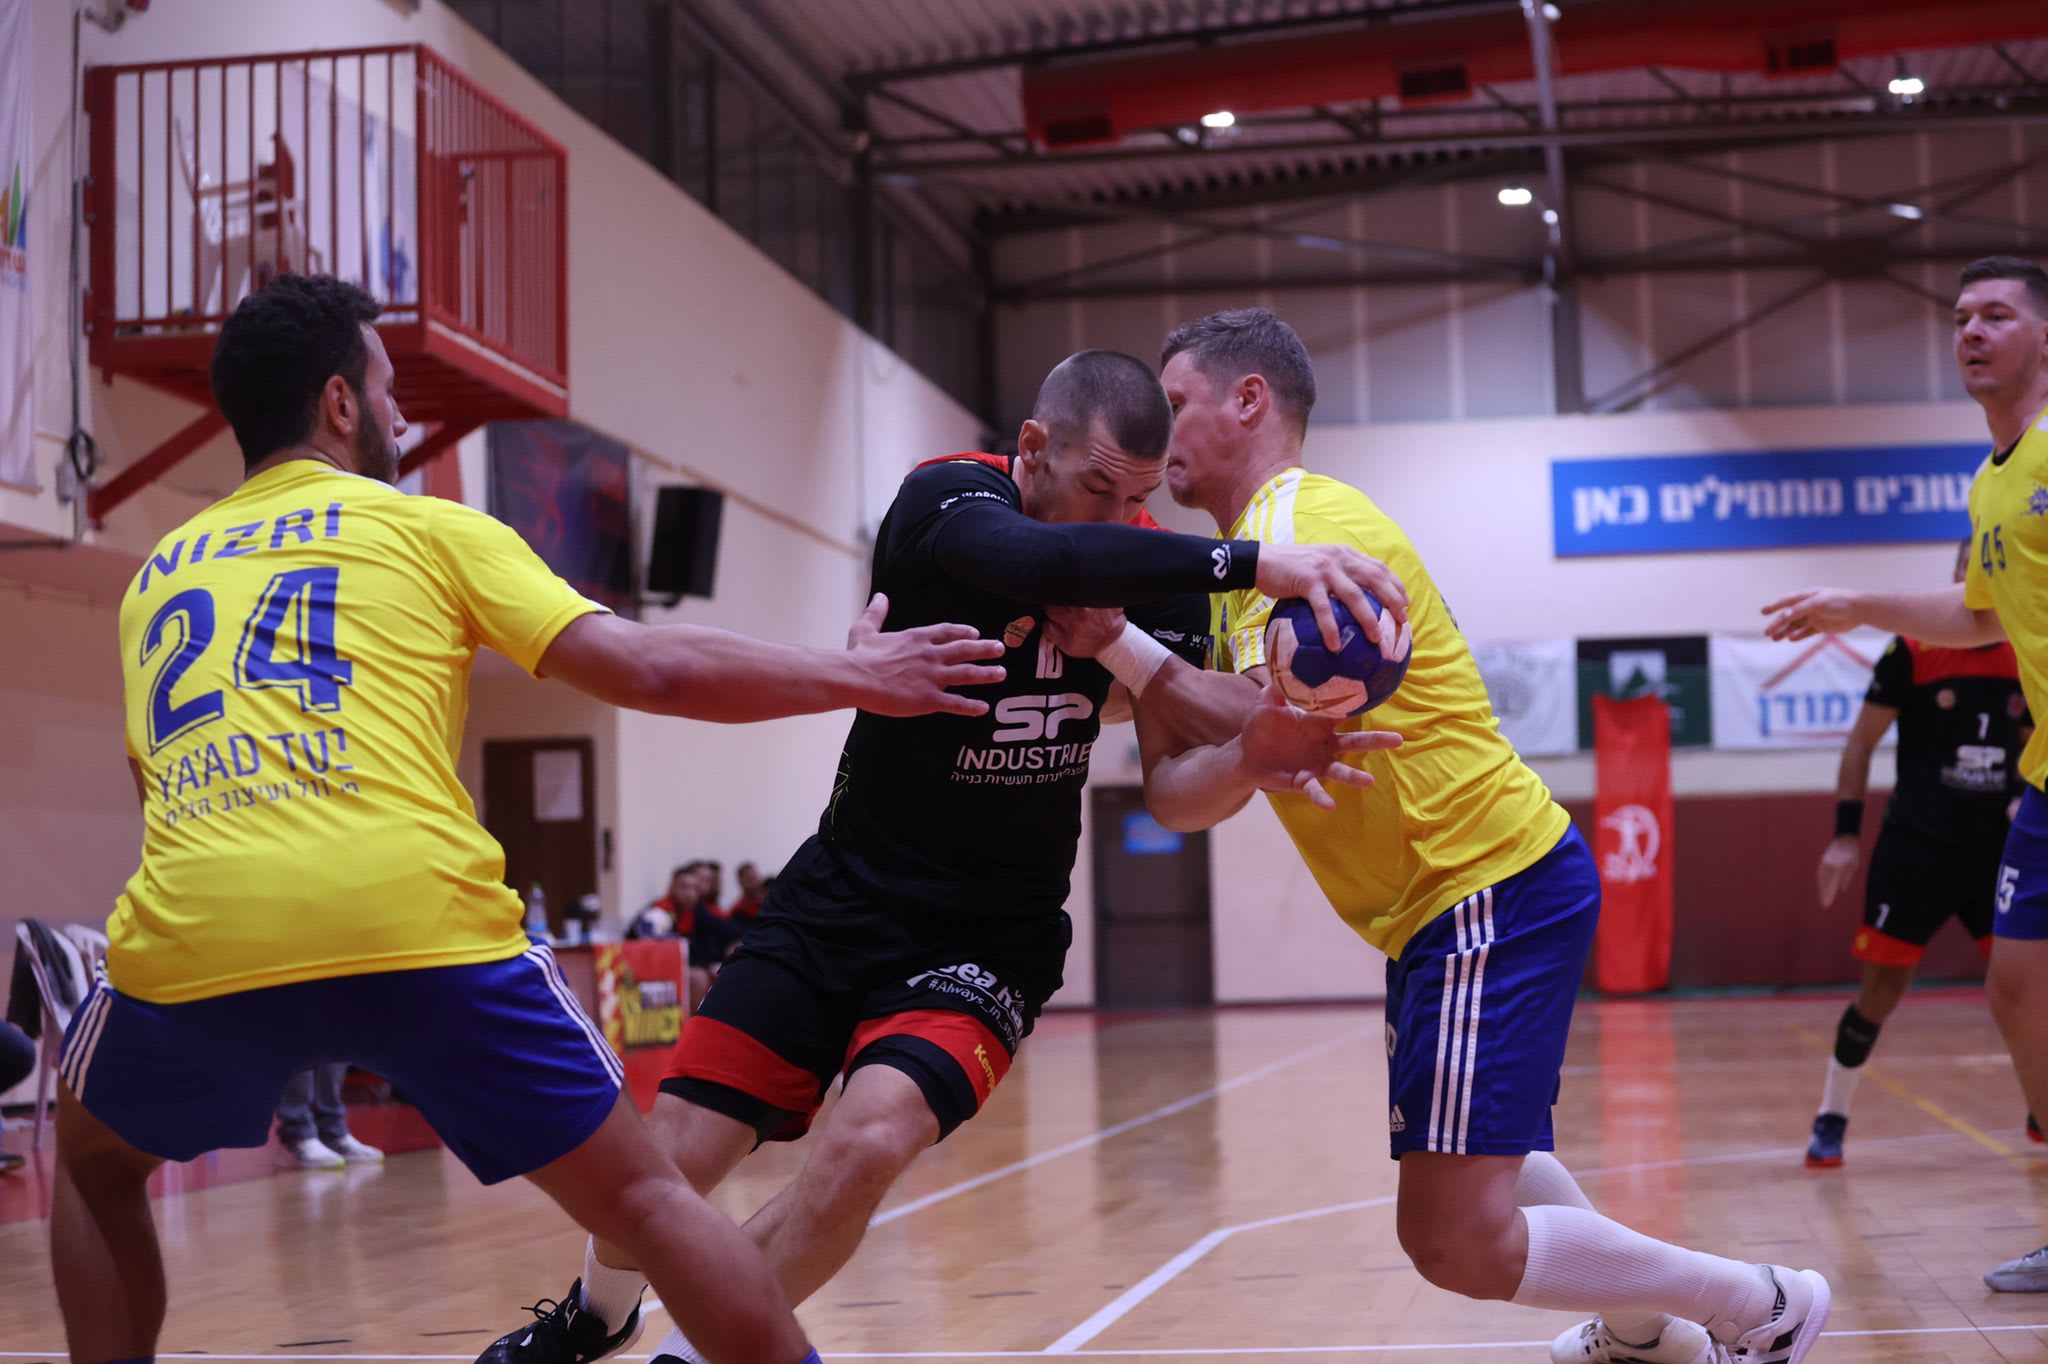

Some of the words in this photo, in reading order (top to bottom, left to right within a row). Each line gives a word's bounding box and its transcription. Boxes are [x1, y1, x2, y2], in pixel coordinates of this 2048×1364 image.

[1573, 485, 1650, 534] כאן
[1658, 475, 1844, 521] מתחילים
[138, 503, 343, 595] NIZRI
[1981, 524, 2007, 577] 45
[140, 566, 353, 757] 24
[992, 693, 1094, 742] SP
[1759, 692, 1862, 737] מודן
[1977, 712, 1989, 740] 1
[156, 733, 261, 803] YA'AD
[1998, 866, 2020, 914] 5
[974, 1043, 996, 1090] Kemp
